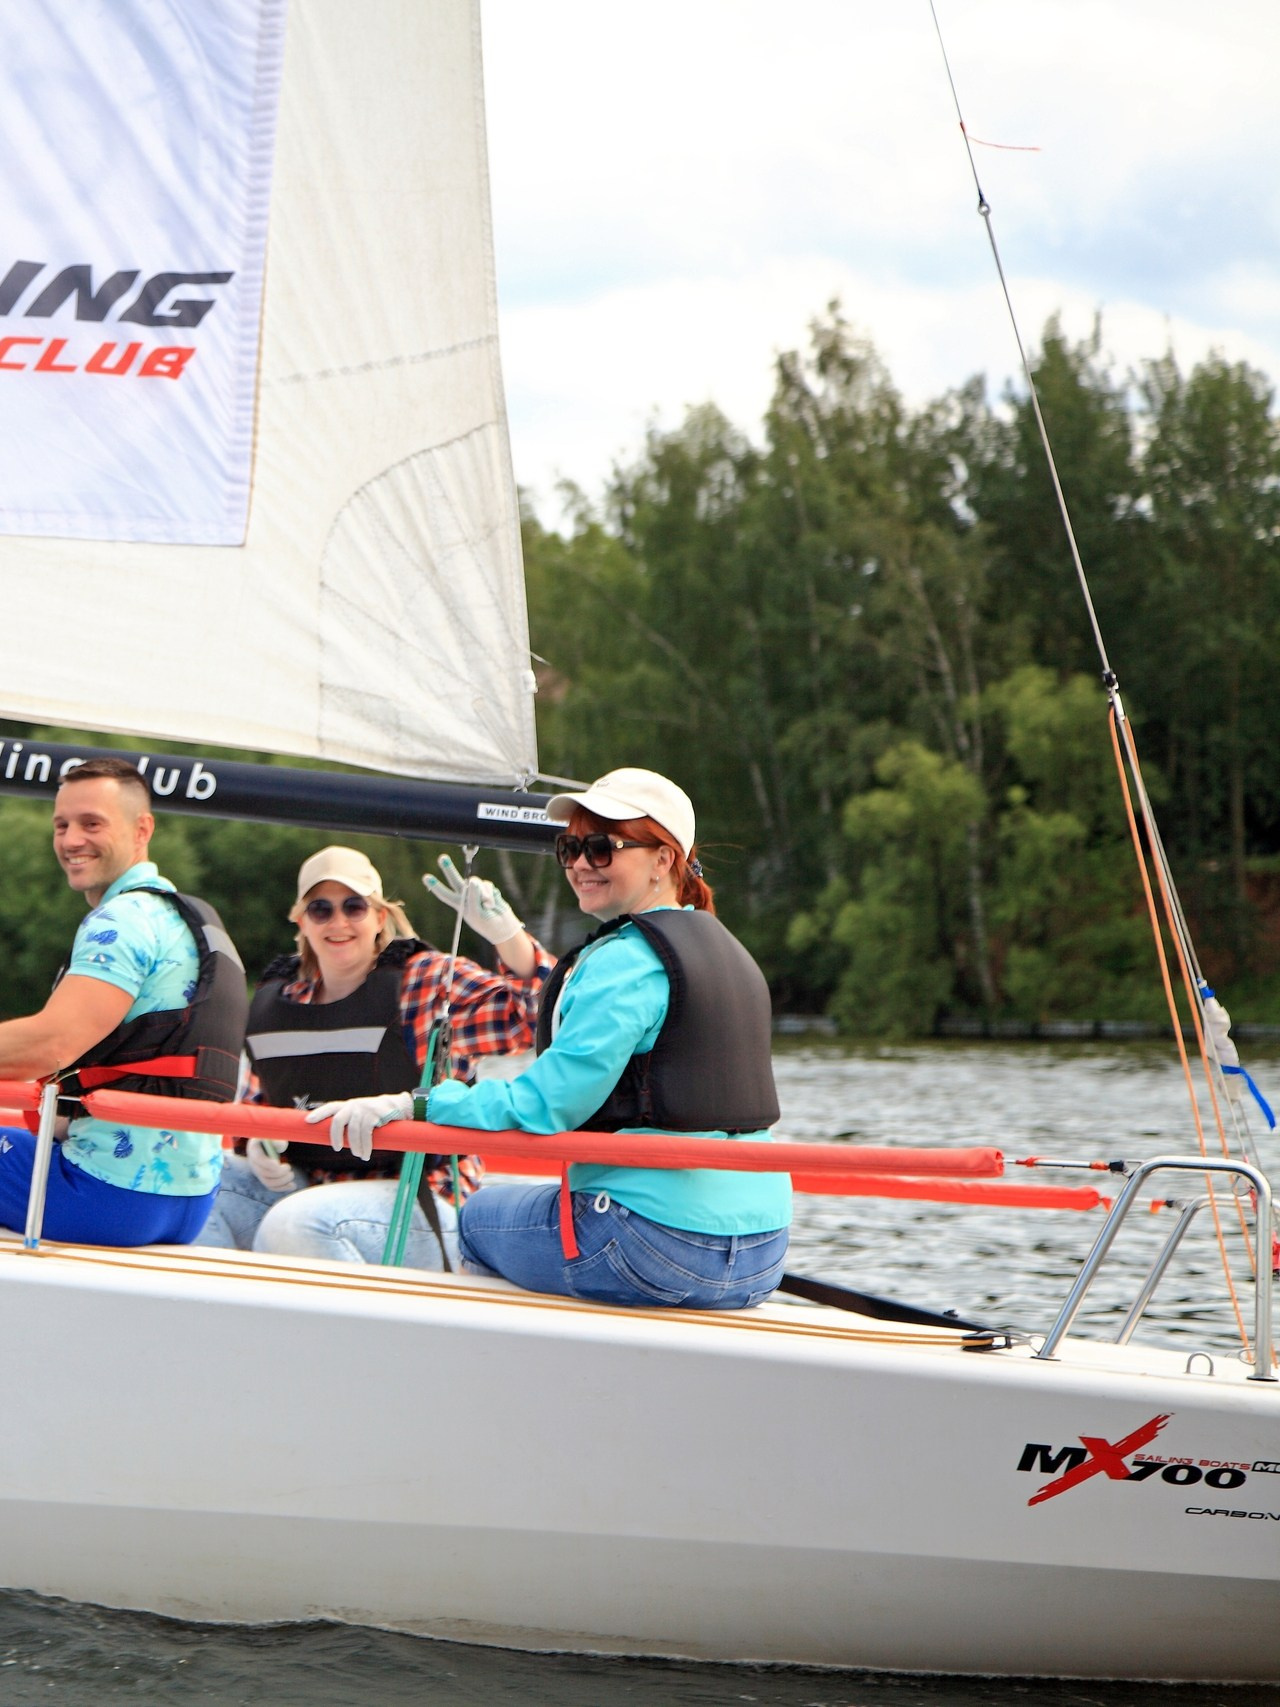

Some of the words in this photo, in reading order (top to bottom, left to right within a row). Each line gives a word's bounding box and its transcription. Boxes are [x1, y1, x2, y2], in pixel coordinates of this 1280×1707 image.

[485, 807, 519, 819] WIND
[523, 811, 549, 821] BRO
[1134, 1453, 1194, 1466] SAILING
[1198, 1459, 1252, 1471] BOATS
